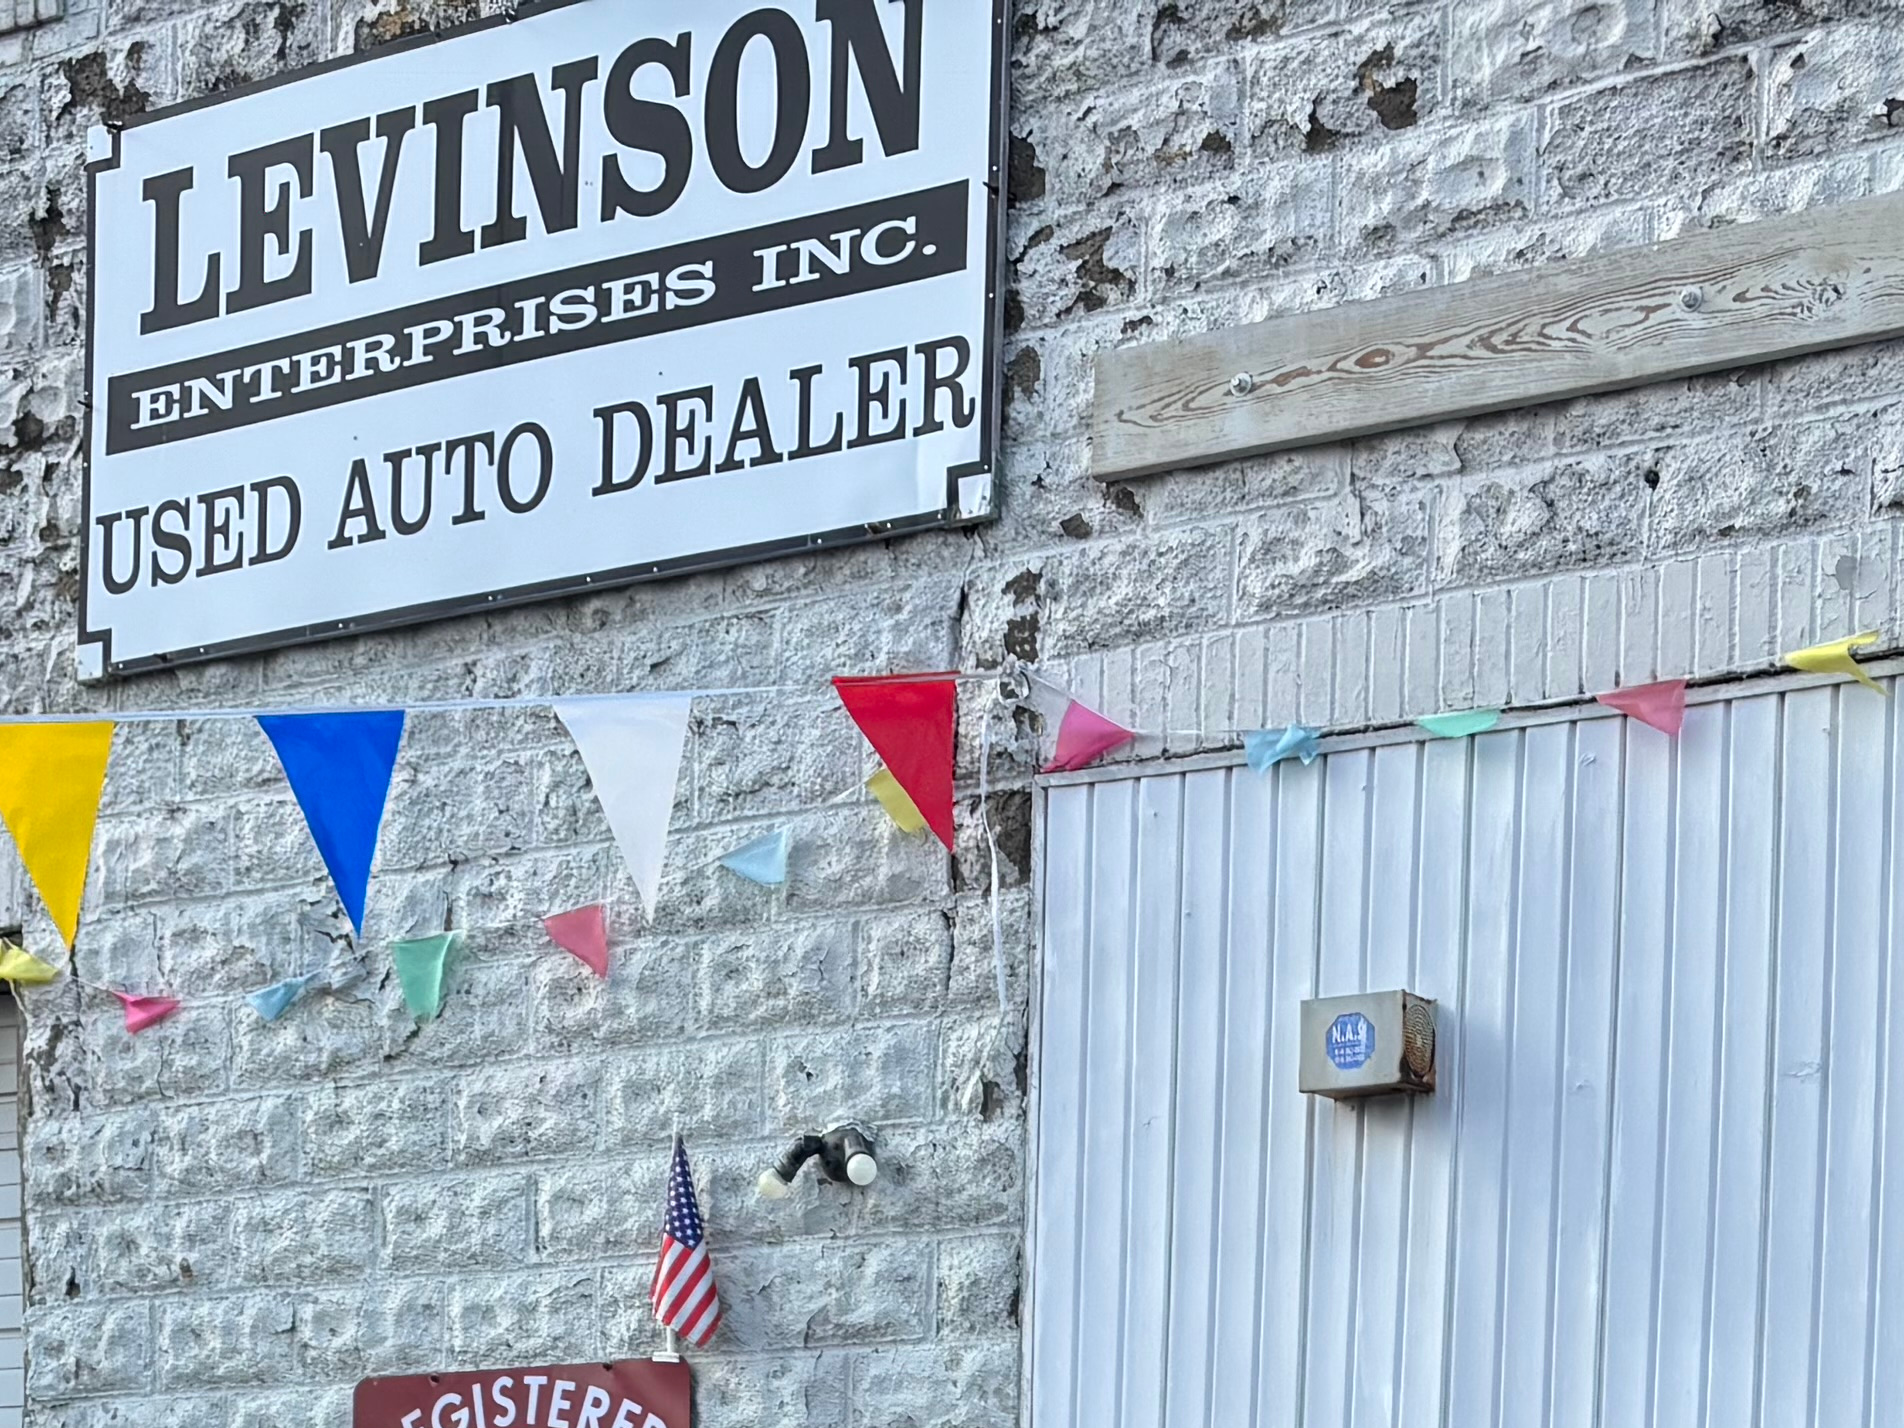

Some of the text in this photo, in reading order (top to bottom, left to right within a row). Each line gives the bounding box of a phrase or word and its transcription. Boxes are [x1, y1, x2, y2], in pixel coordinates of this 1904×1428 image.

[140, 0, 925, 335] LEVINSON
[130, 217, 939, 431] ENTERPRISES INC.
[95, 334, 977, 596] USED AUTO DEALER
